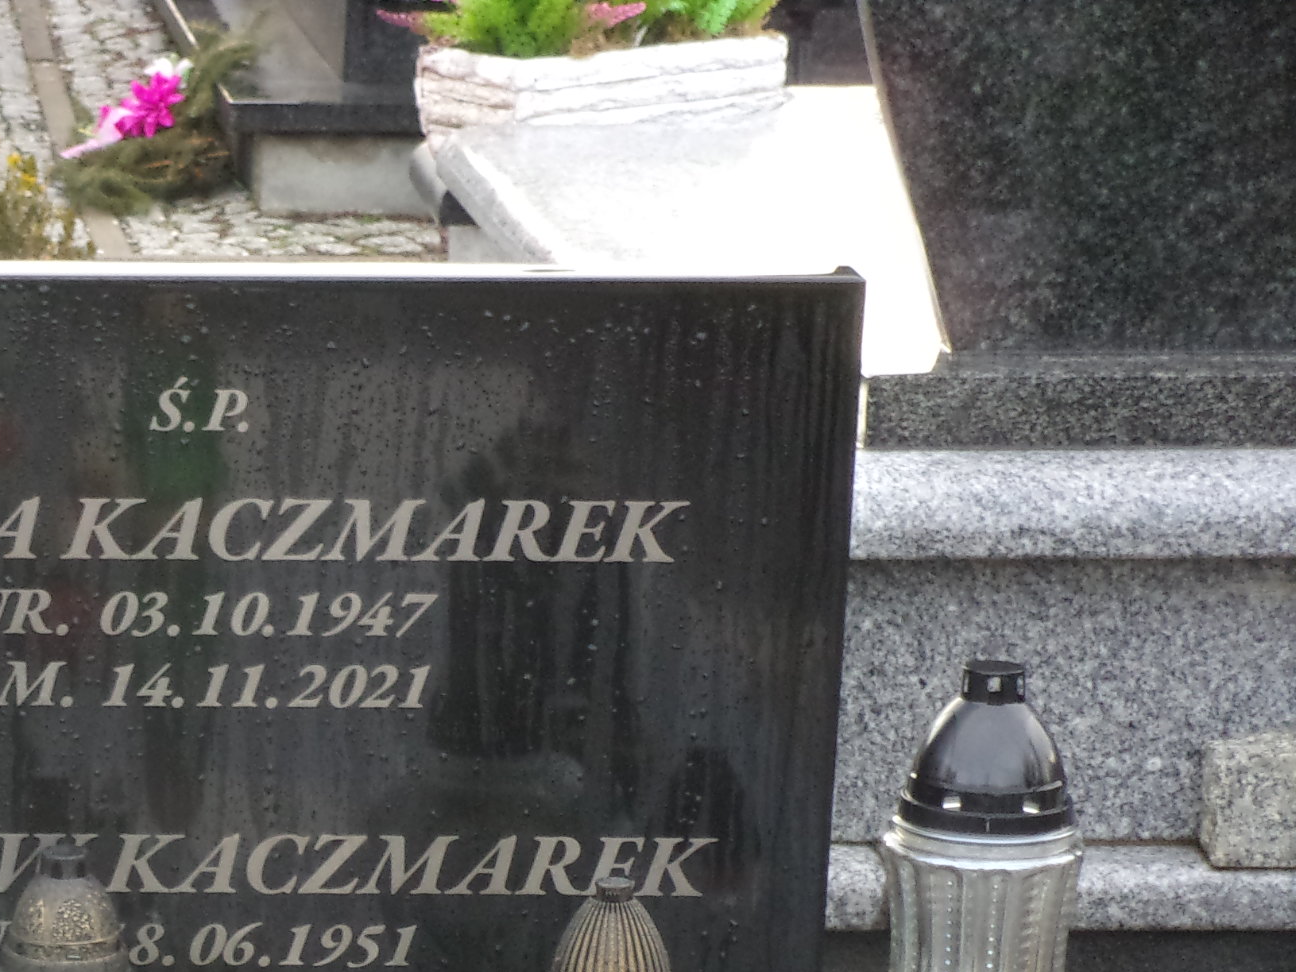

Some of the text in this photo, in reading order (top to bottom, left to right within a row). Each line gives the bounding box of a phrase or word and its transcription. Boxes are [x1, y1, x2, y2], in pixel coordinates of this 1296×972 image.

[149, 377, 249, 433] Ś.P.
[59, 496, 691, 563] KACZMAREK
[99, 590, 440, 639] 03.10.1947
[101, 662, 432, 709] 14.11.2021
[104, 832, 719, 897] KACZMAREK
[120, 921, 418, 968] 8.06.1951
